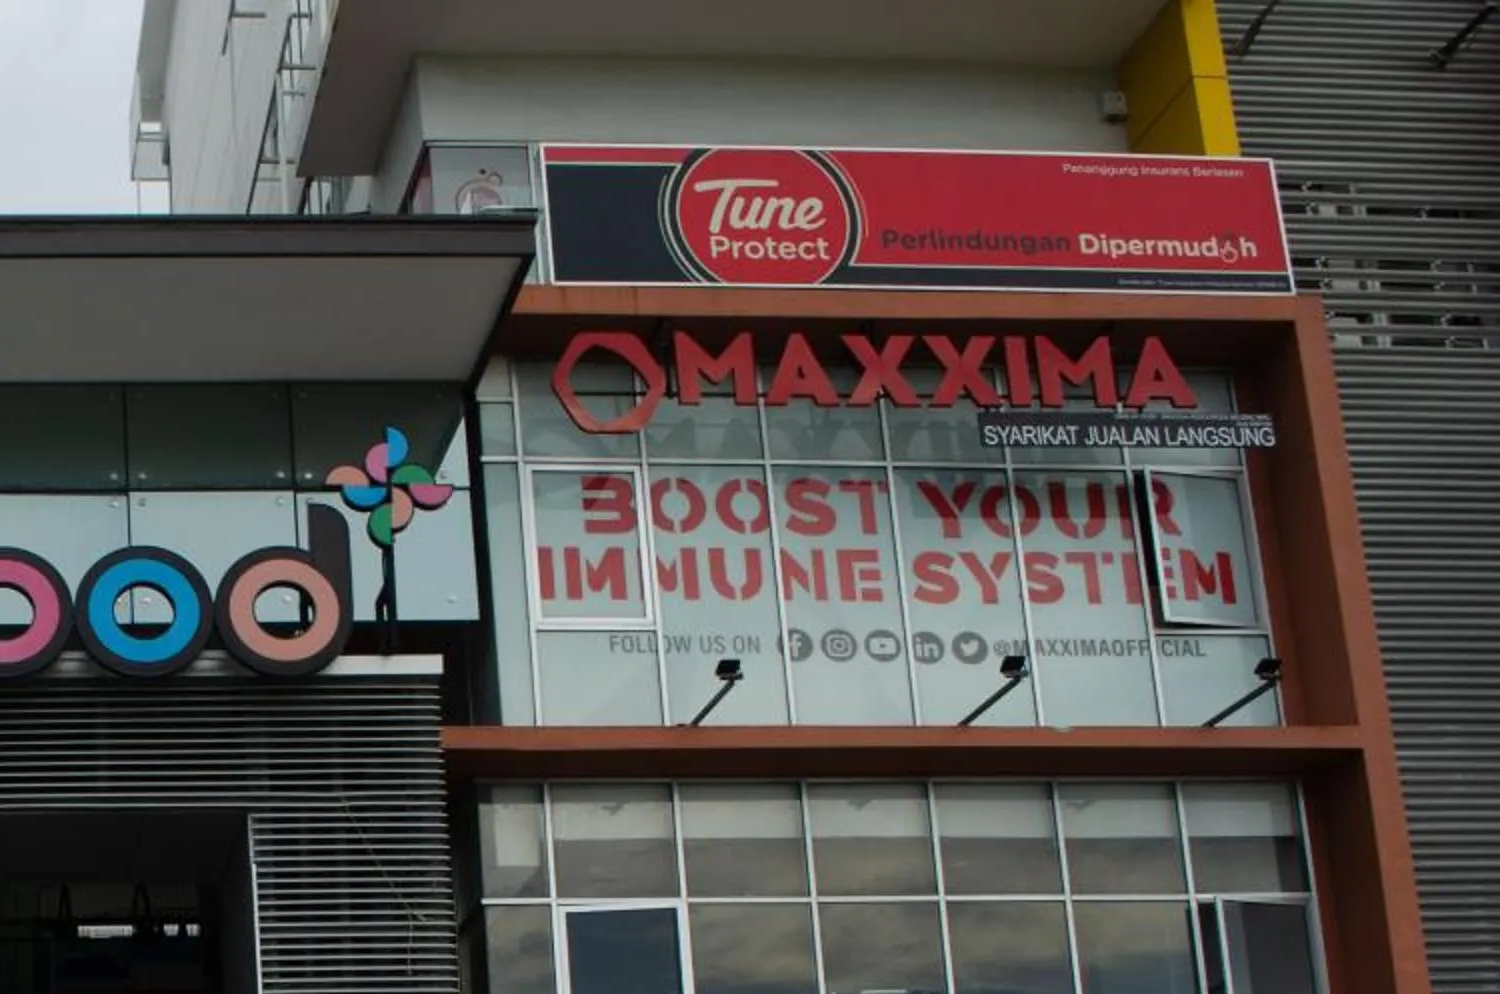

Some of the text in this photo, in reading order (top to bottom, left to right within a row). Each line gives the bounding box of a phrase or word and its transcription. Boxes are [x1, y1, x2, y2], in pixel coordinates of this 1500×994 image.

[694, 178, 827, 234] Tune
[709, 235, 831, 260] Protect
[881, 229, 1071, 256] Perlindungan
[672, 331, 1197, 408] MAXXIMA
[983, 425, 1276, 447] SYARIKAT JUALAN LANGSUNG
[580, 475, 1182, 540] BOOST YOUR
[537, 546, 1238, 606] IMMUNE SYSTEM
[700, 634, 726, 654] US
[733, 634, 762, 654] ON
[993, 637, 1208, 658] @MAXXIMAOFFCIAL
